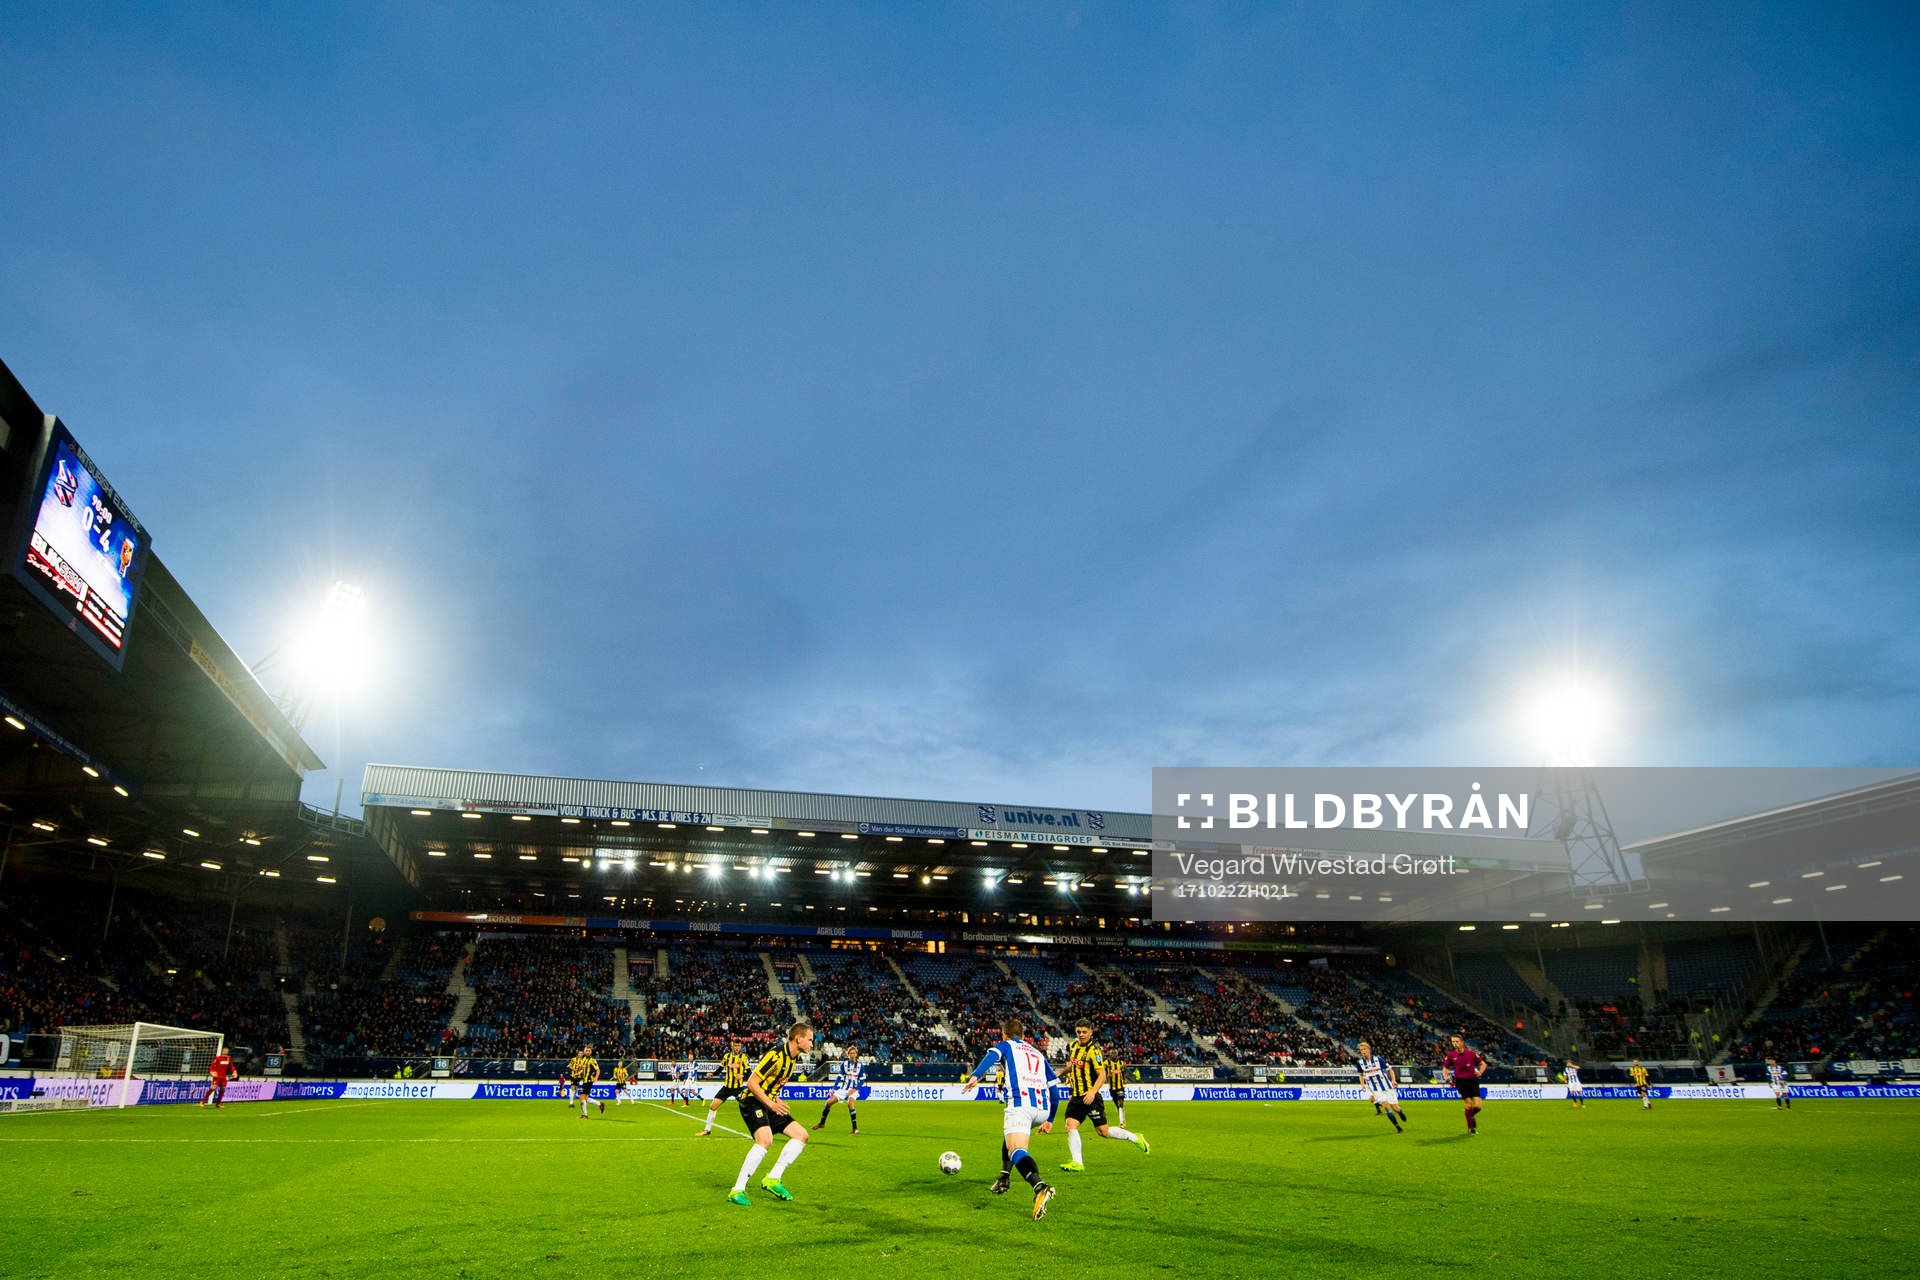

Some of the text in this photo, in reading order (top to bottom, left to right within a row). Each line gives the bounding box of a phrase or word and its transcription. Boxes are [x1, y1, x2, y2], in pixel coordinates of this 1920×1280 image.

[113, 493, 141, 533] ELECTRIC
[82, 506, 94, 531] 0
[99, 529, 111, 552] 4
[560, 805, 583, 817] VOLVO
[586, 806, 610, 818] TRUCK
[612, 808, 618, 818] &
[621, 808, 635, 820] BUS
[642, 810, 657, 821] M.S.
[659, 811, 668, 821] DE
[670, 812, 692, 823] VRIES
[693, 813, 699, 823] &
[701, 813, 711, 824] ZN
[895, 826, 915, 834] Schaaf
[618, 919, 650, 929] FOODLOGE
[689, 922, 721, 932] FOODLOGE
[817, 927, 845, 937] AGRILOGE
[1025, 1052, 1040, 1073] 17
[147, 1082, 178, 1100] Wierda
[484, 1085, 532, 1097] Wierda
[1199, 1088, 1236, 1099] Wierda
[1250, 1088, 1294, 1099] Partners
[1396, 1088, 1428, 1098] Wierda
[1788, 1087, 1837, 1097] Wierda
[1857, 1086, 1920, 1097] Partners
